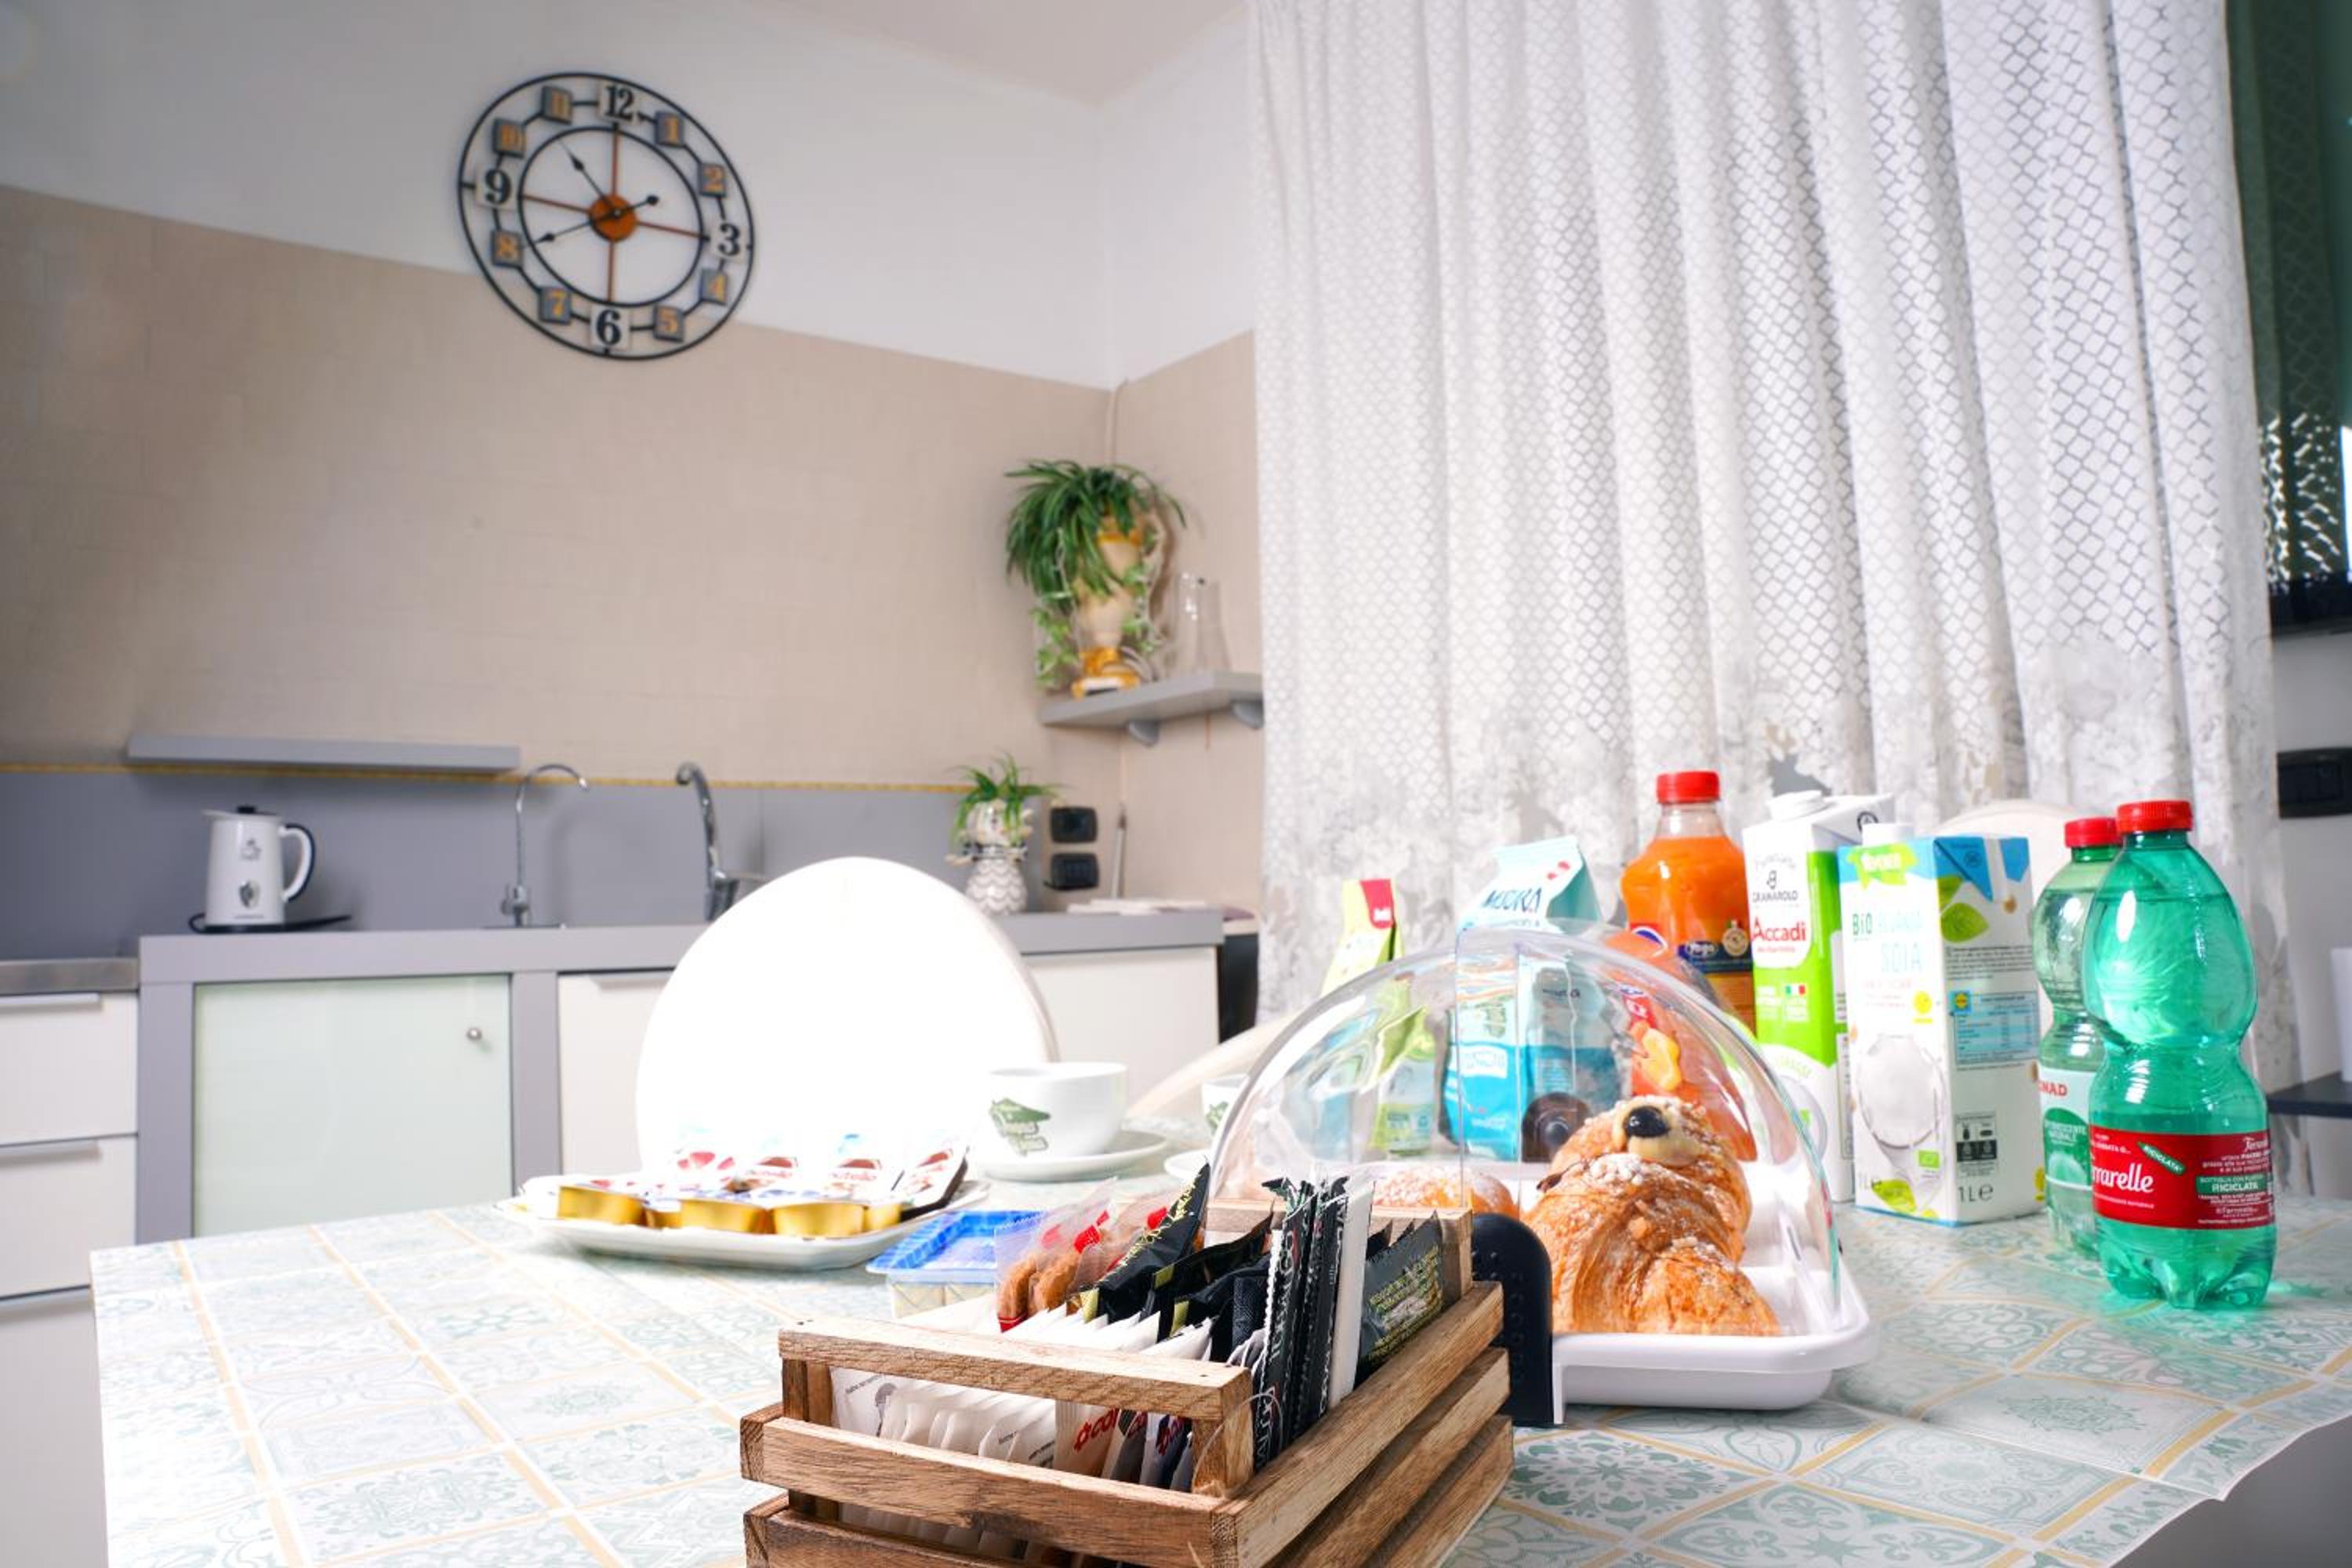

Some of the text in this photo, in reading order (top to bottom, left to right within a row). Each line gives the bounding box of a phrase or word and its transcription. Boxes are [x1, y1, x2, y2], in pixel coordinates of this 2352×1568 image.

[604, 85, 634, 121] 12
[485, 169, 511, 204] 9
[704, 167, 722, 193] 2
[718, 223, 740, 256] 3
[550, 289, 566, 318] 7
[596, 310, 620, 346] 6
[660, 309, 678, 336] 5
[1751, 916, 1806, 942] Accadi
[2038, 1081, 2067, 1096] NAD
[2212, 1181, 2259, 1192] RICICLATA
